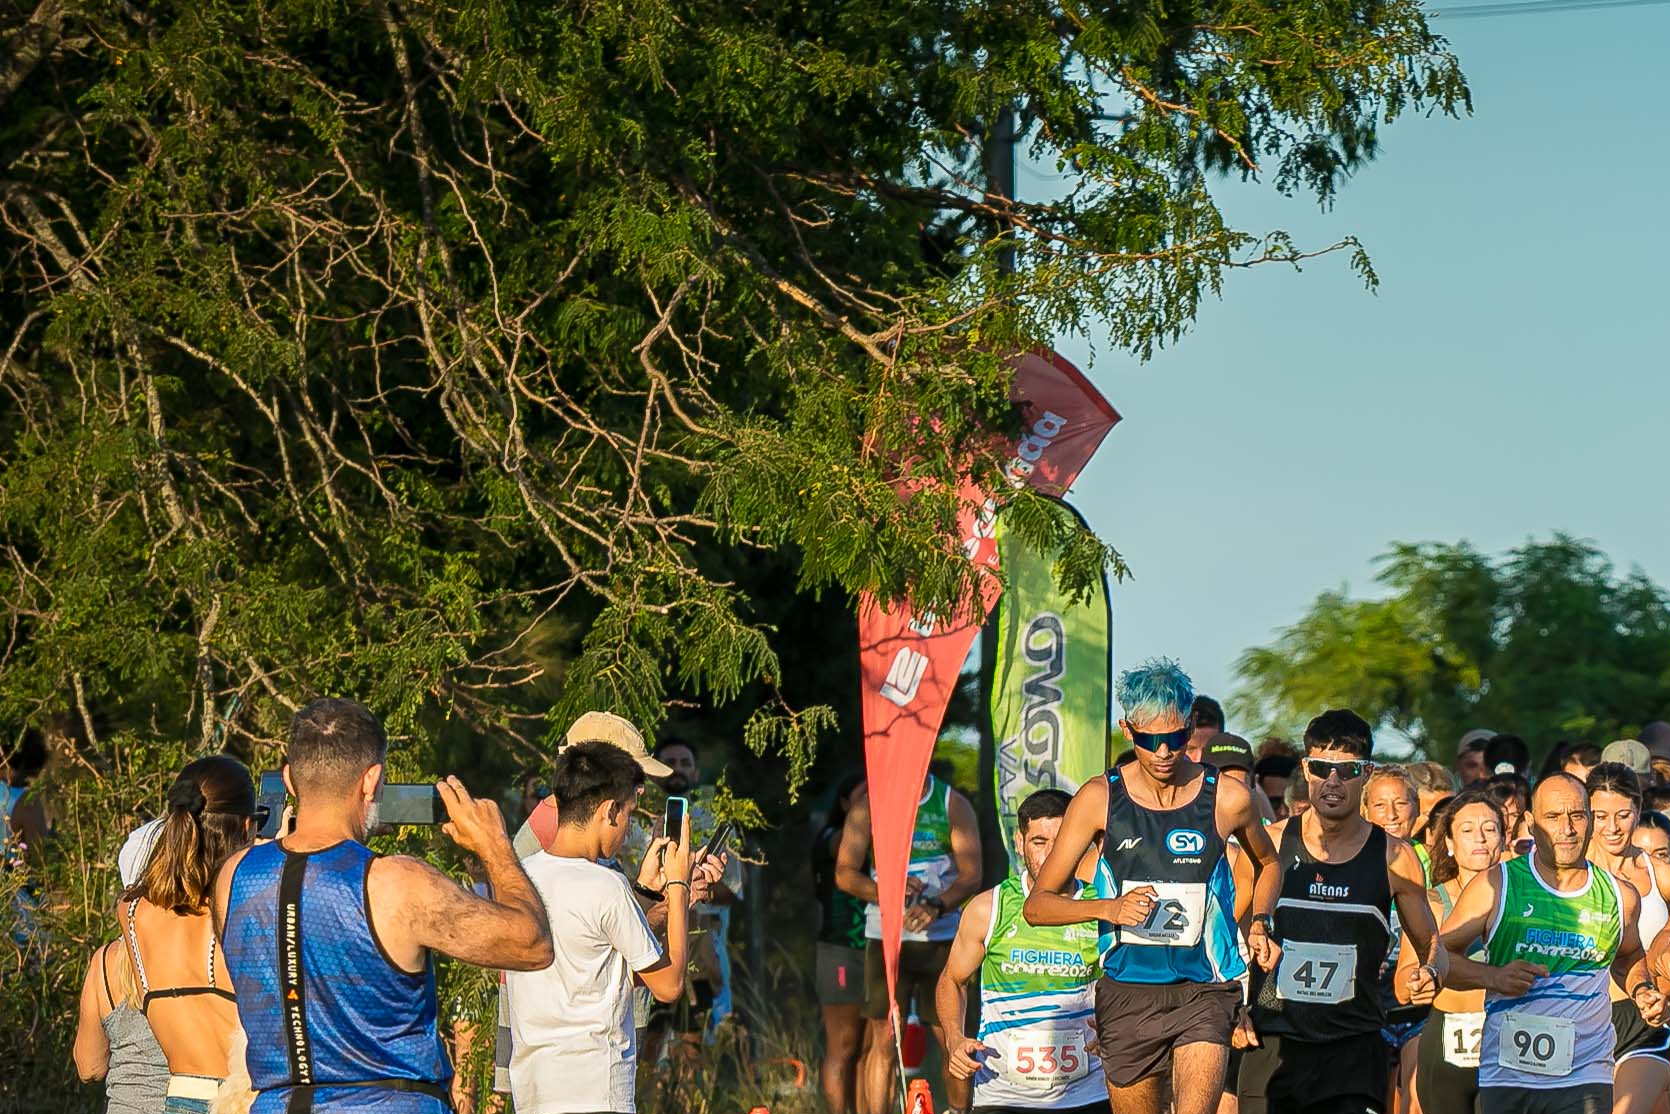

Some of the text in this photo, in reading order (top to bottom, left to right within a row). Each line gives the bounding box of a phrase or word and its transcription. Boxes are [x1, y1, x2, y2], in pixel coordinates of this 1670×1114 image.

[1175, 834, 1199, 853] SM
[1309, 882, 1351, 897] ATENAS
[286, 903, 298, 986] URBAN/LUXURY
[1526, 927, 1597, 950] FIGHIERA
[1010, 949, 1084, 966] FIGHIERA
[1292, 960, 1339, 990] 47
[290, 1005, 309, 1077] TECHNOLOGY
[1513, 1030, 1556, 1061] 90
[1016, 1045, 1080, 1074] 535
